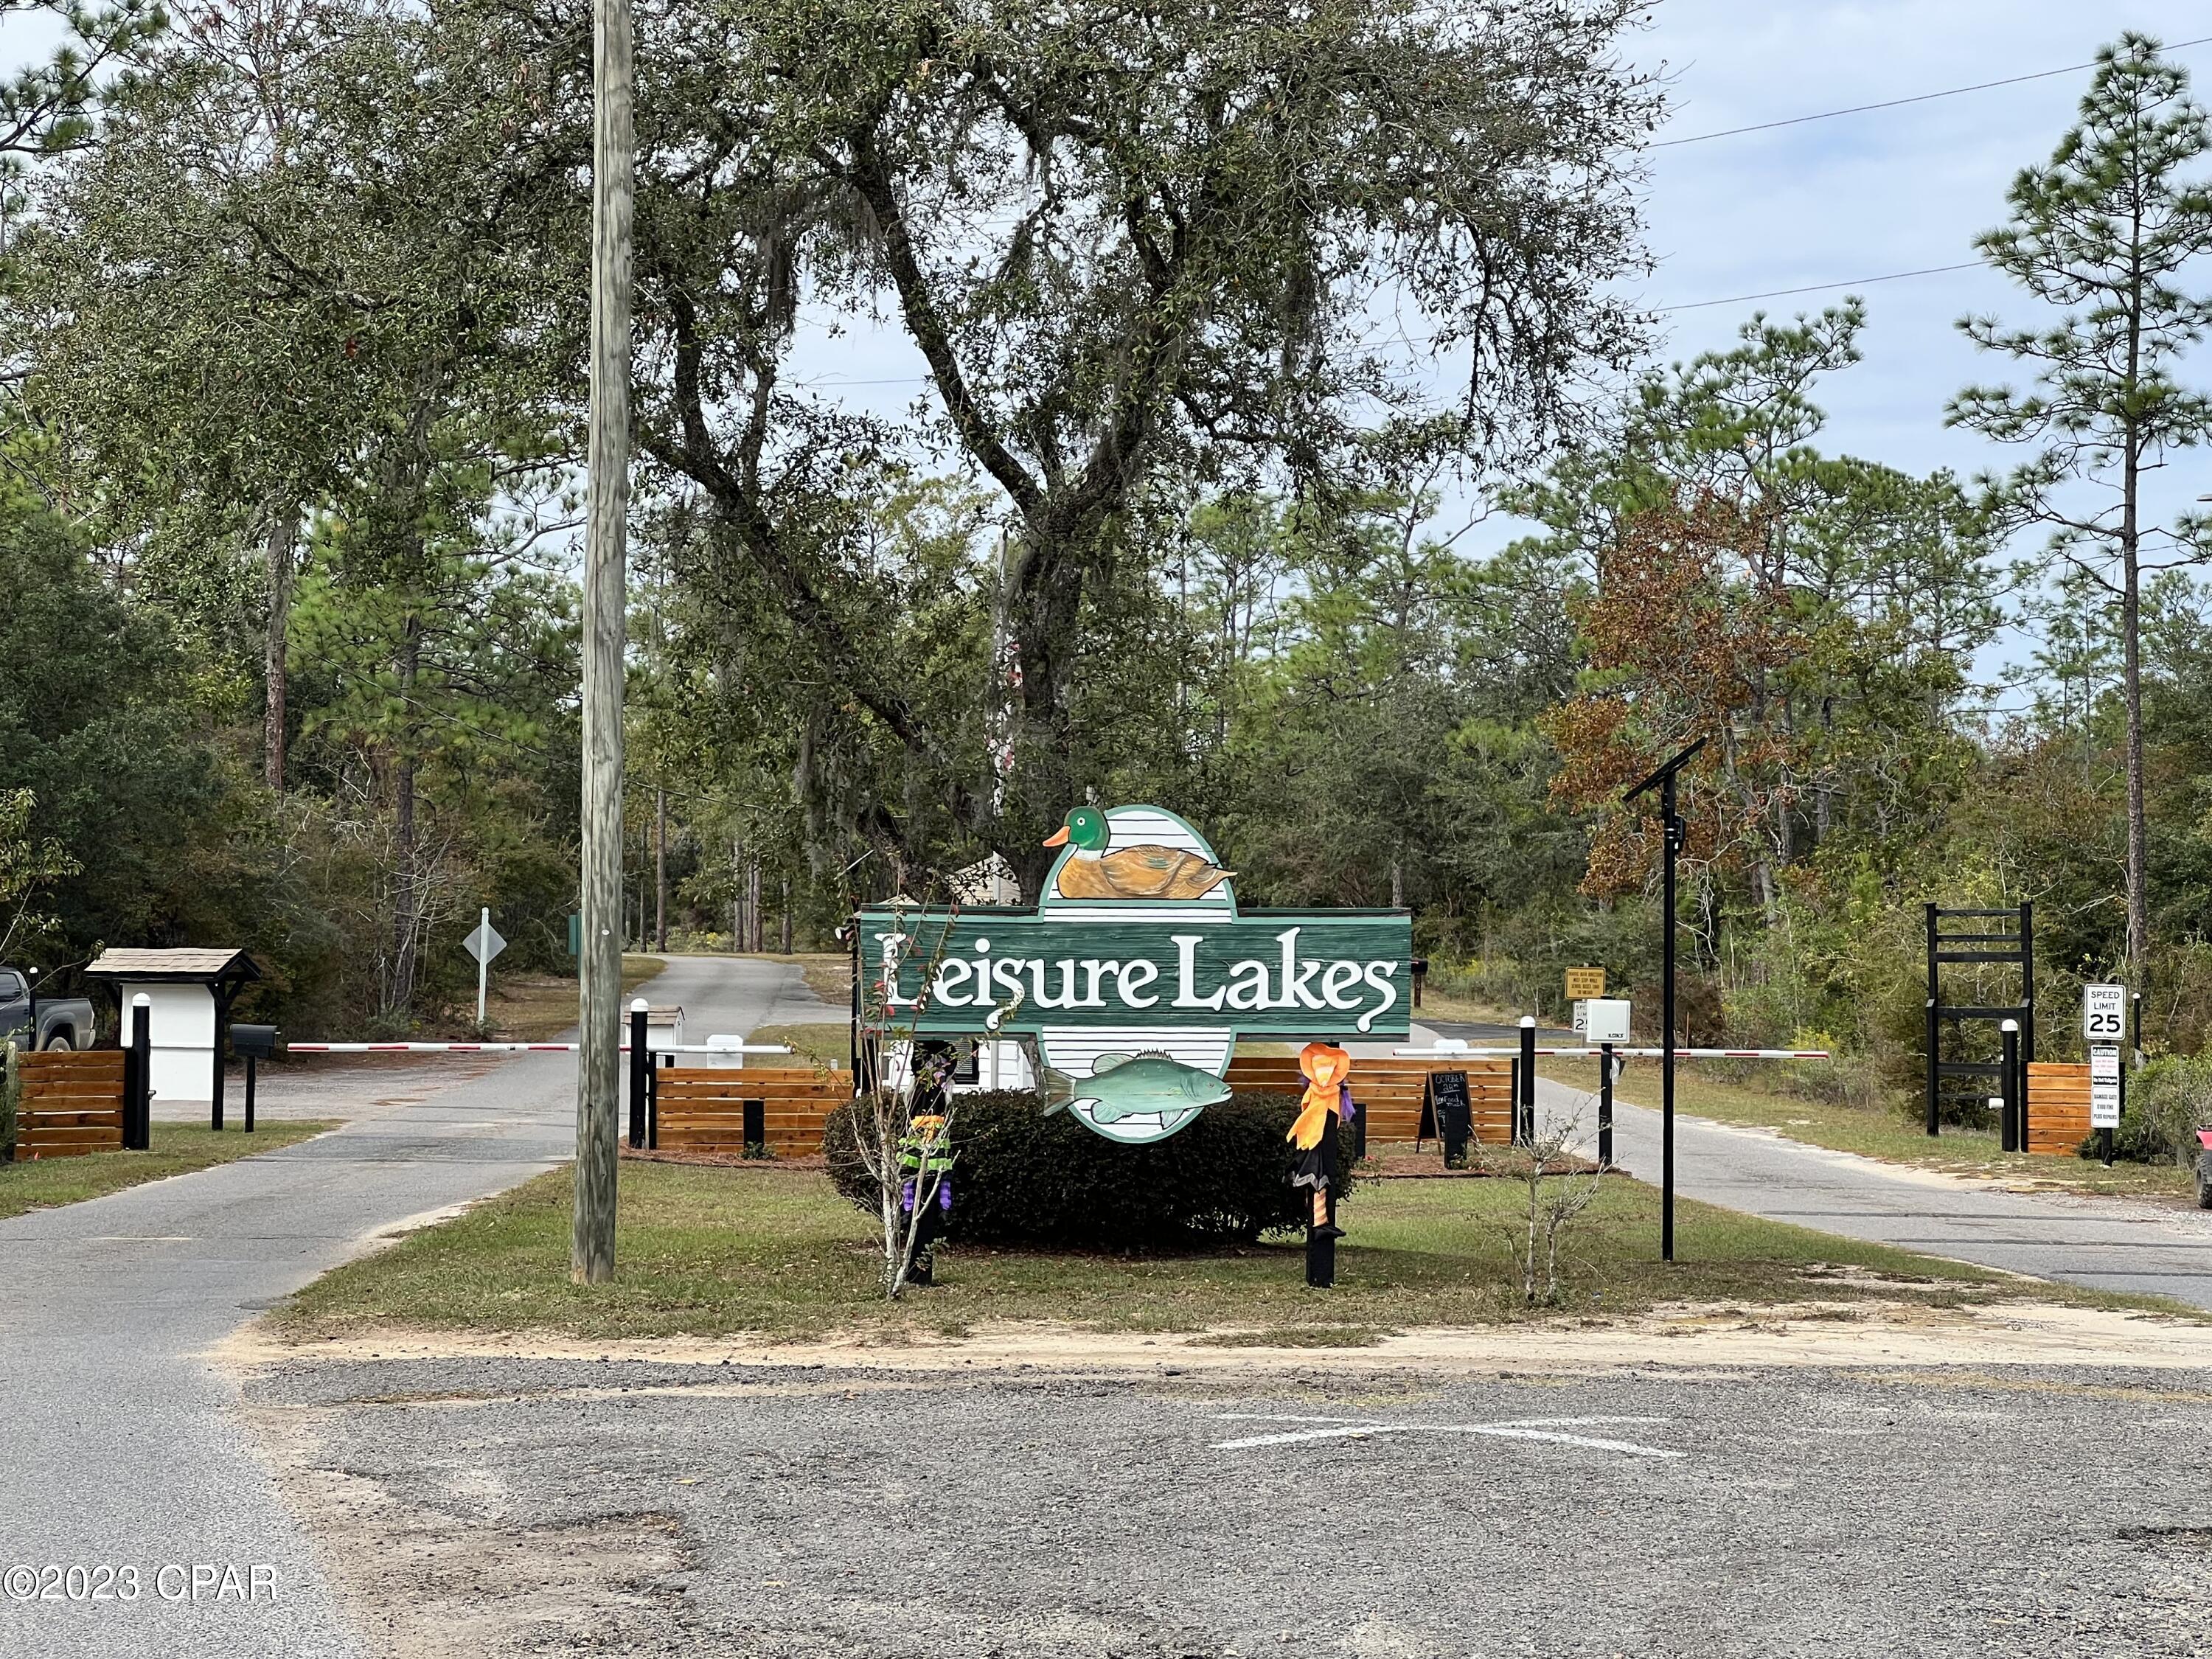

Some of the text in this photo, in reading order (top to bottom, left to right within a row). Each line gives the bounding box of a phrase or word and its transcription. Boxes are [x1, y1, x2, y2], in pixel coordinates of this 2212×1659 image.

[874, 926, 1399, 1032] Leisure Lakes
[2094, 1002, 2116, 1010] LIMIT
[1575, 1019, 1587, 1030] 2
[2090, 1014, 2121, 1033] 25
[2093, 1048, 2117, 1056] CAUTION
[1435, 1074, 1466, 1084] OCTOBER
